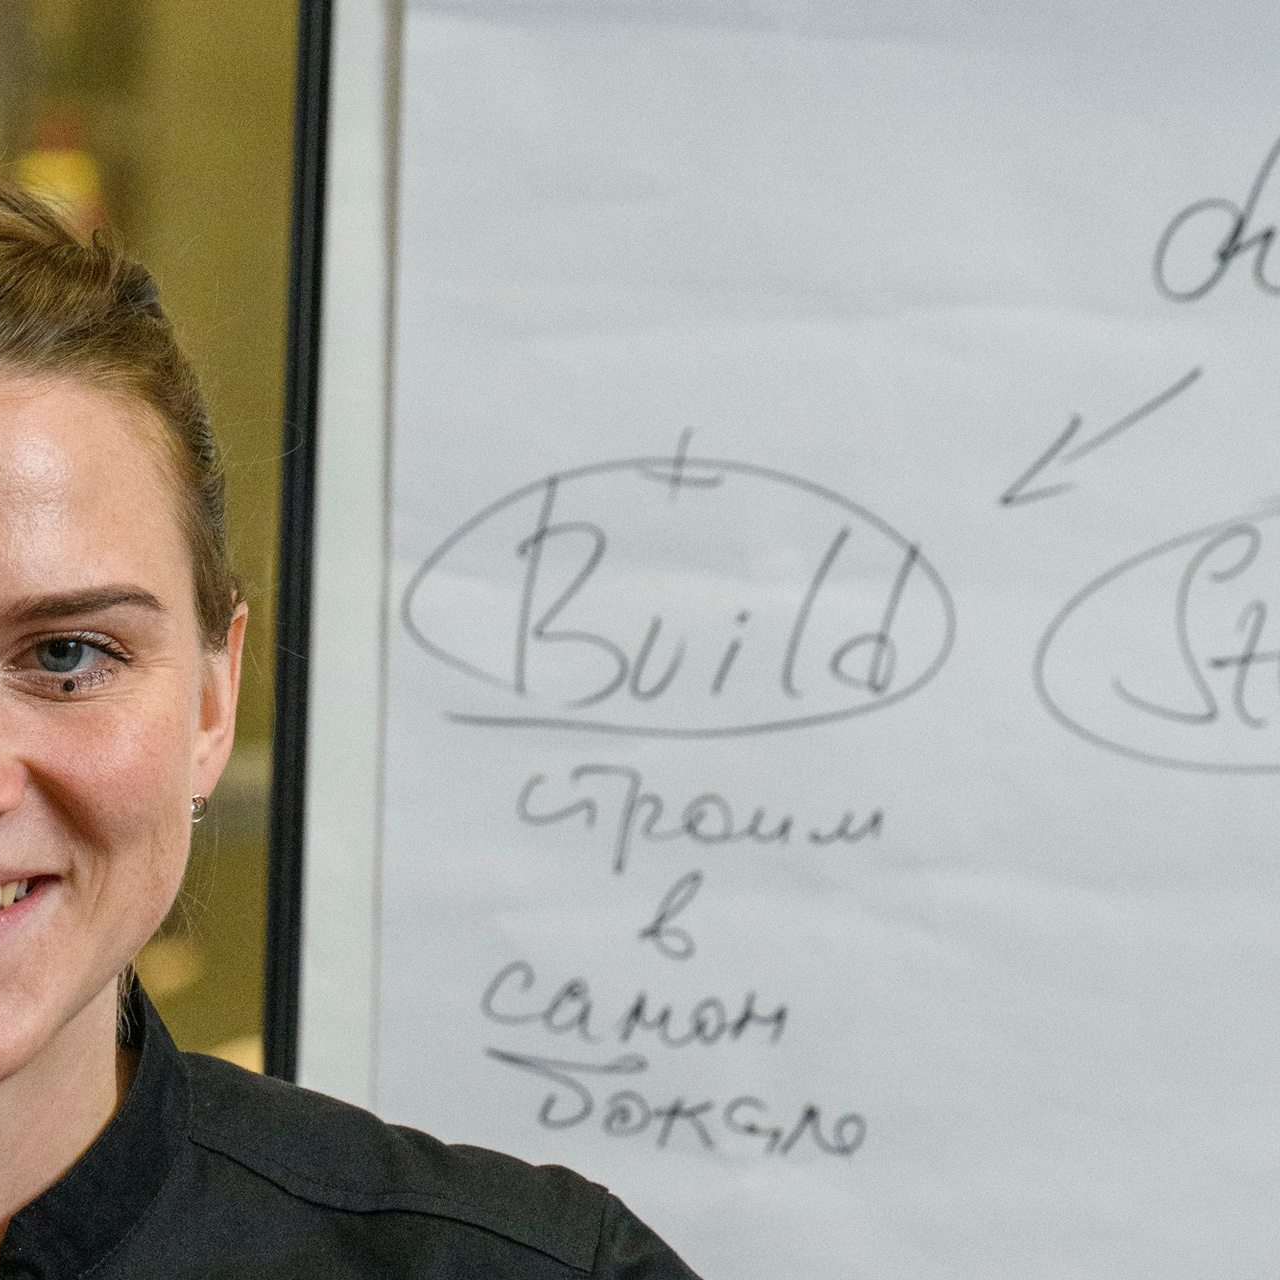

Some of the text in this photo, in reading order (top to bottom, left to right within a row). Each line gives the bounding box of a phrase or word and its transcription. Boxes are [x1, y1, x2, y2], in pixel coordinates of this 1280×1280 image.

[514, 473, 920, 710] Build
[1111, 523, 1280, 729] St
[515, 763, 885, 875] строим
[638, 870, 704, 960] в
